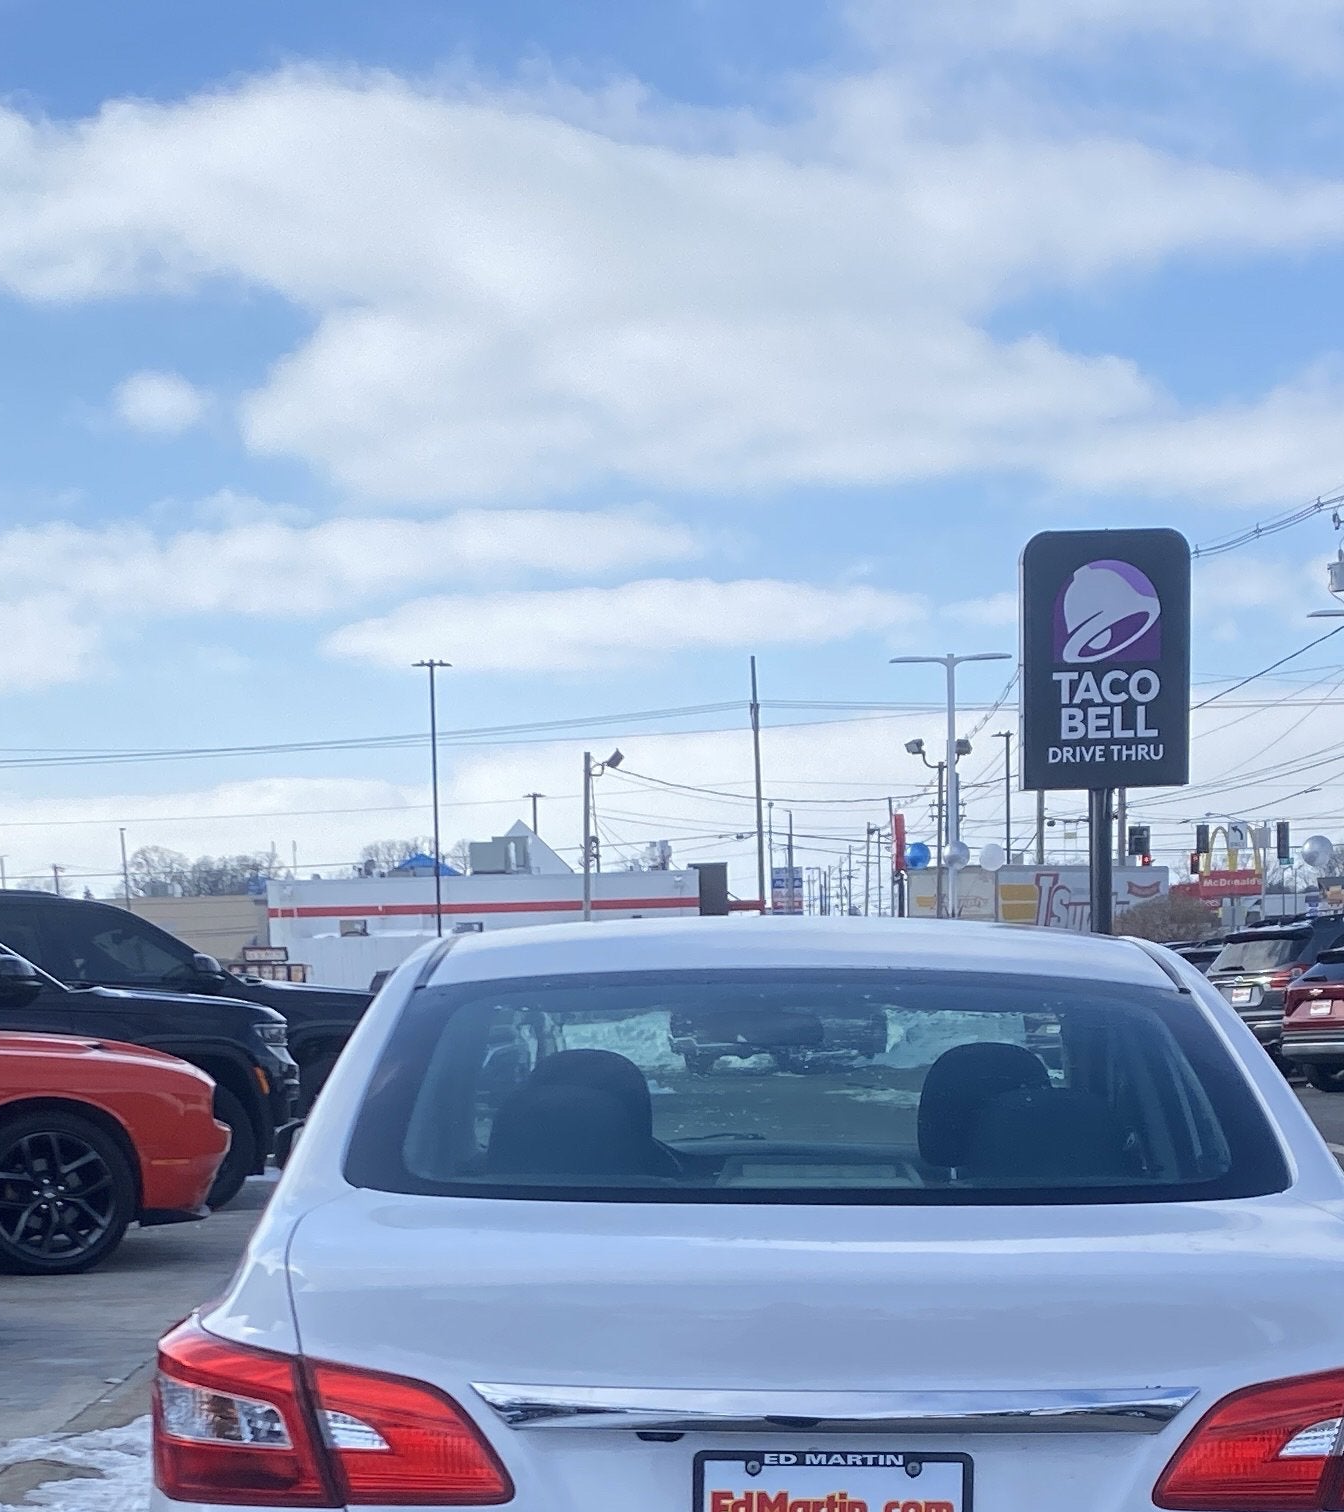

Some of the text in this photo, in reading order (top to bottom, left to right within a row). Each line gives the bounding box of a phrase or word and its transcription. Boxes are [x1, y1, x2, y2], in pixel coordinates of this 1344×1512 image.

[1052, 669, 1161, 704] TACO
[1060, 705, 1159, 740] BELL
[1048, 744, 1164, 764] DRIVE THRU
[764, 1453, 905, 1466] ED MARTIN
